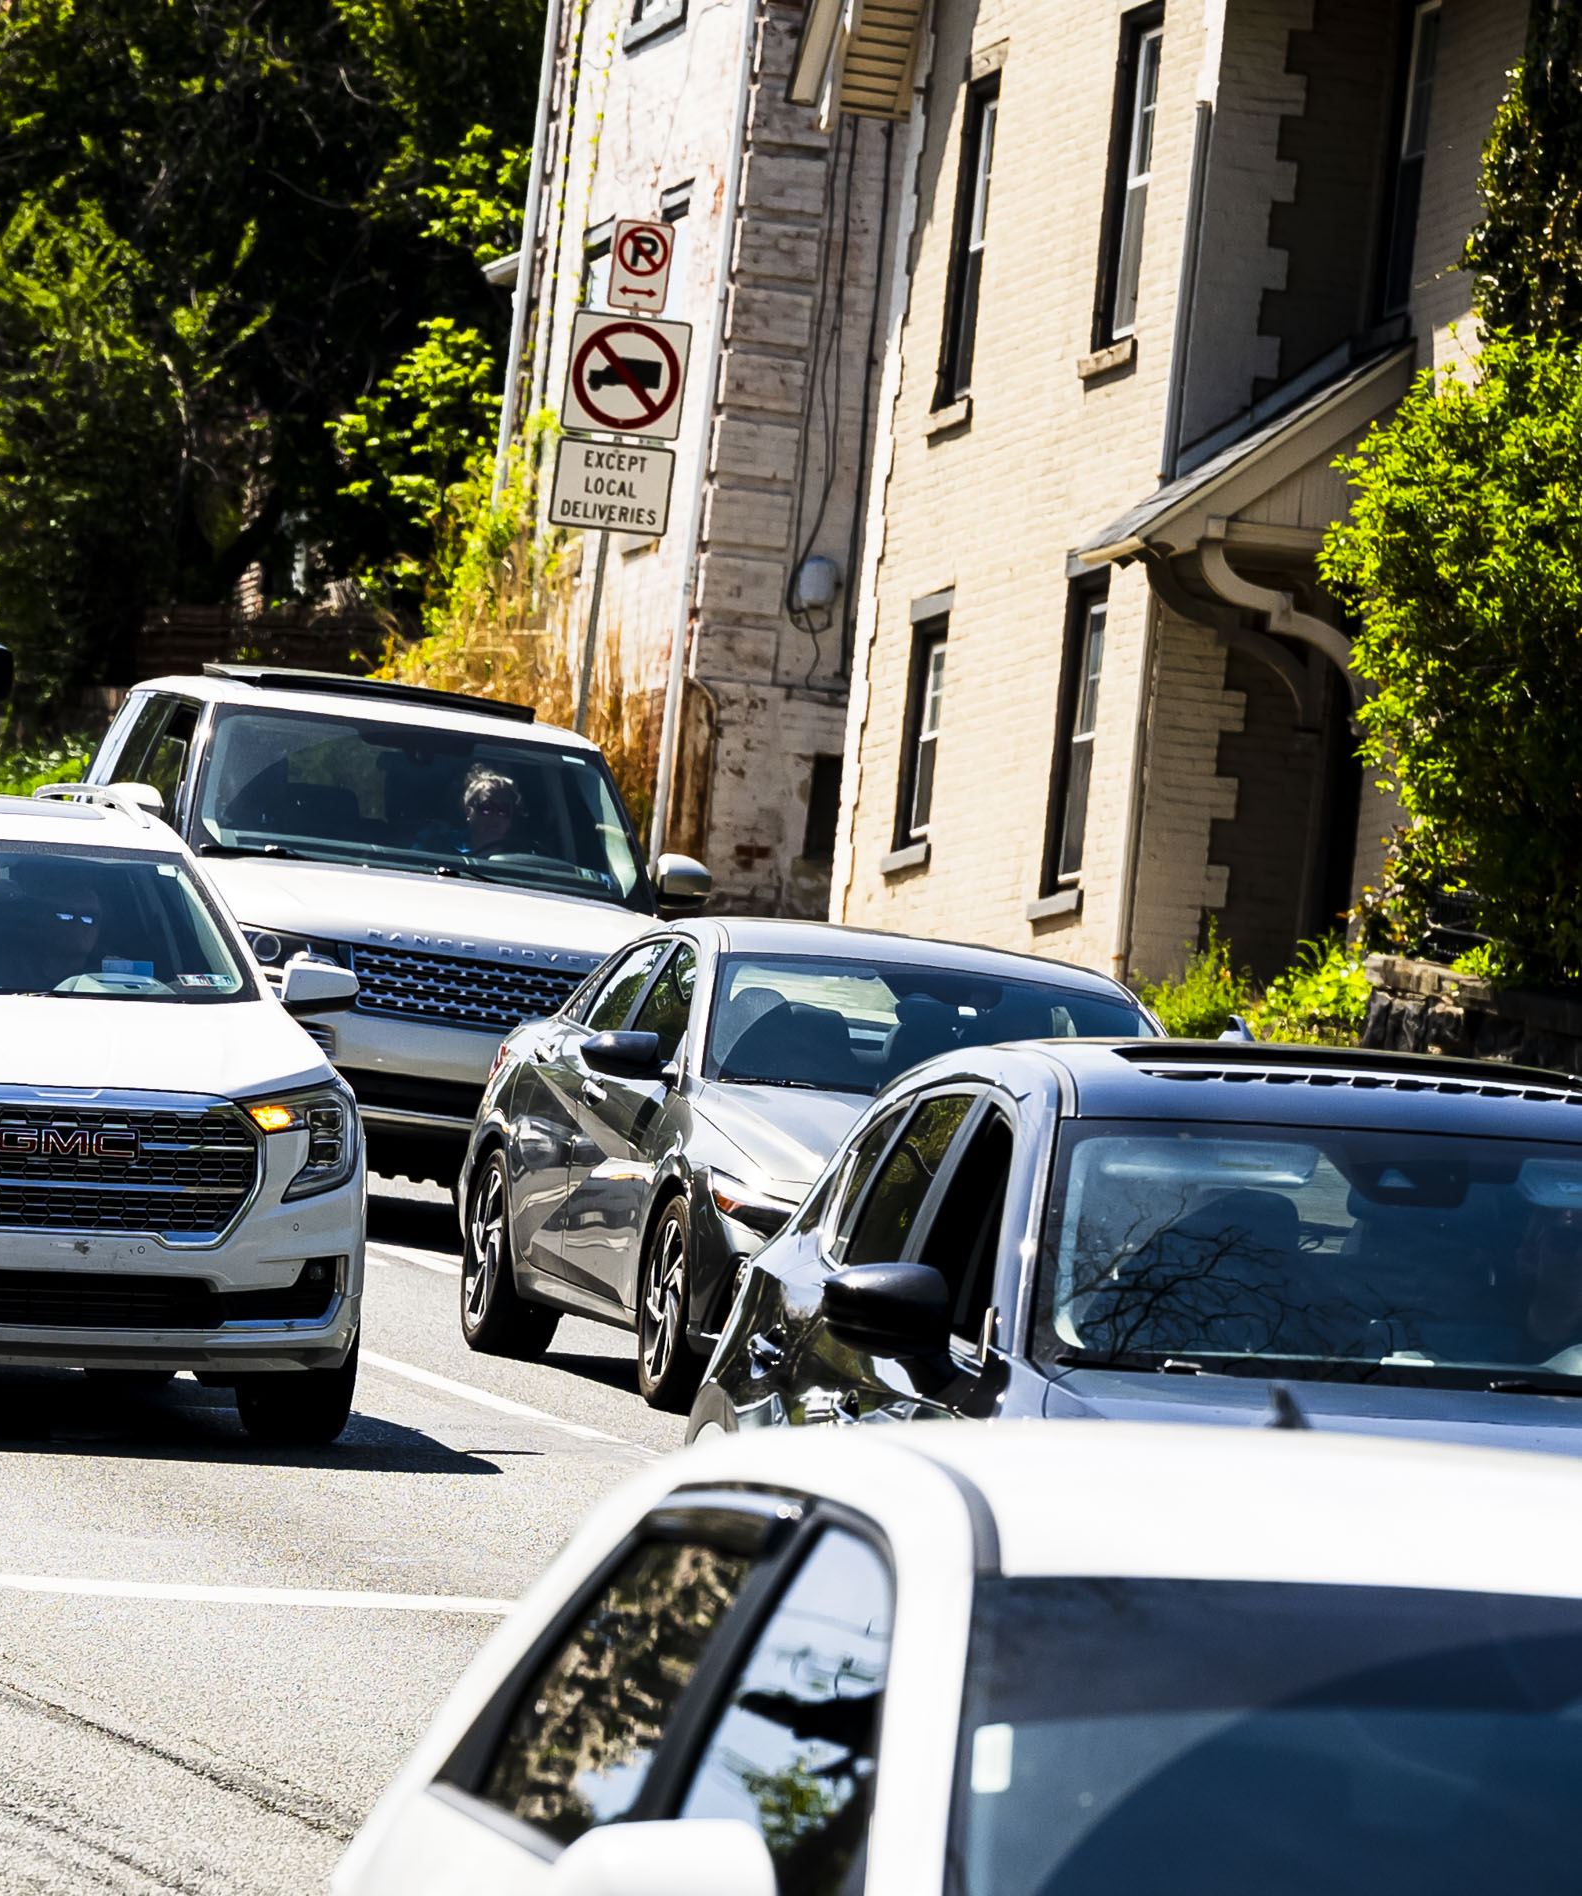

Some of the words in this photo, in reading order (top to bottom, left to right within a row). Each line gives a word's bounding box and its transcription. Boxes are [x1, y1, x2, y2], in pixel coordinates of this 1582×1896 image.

[583, 449, 648, 475] EXCEPT
[584, 476, 637, 499] LOCAL
[560, 499, 657, 526] DELIVERIES
[366, 927, 477, 953] RANGE
[498, 945, 603, 968] ROVER
